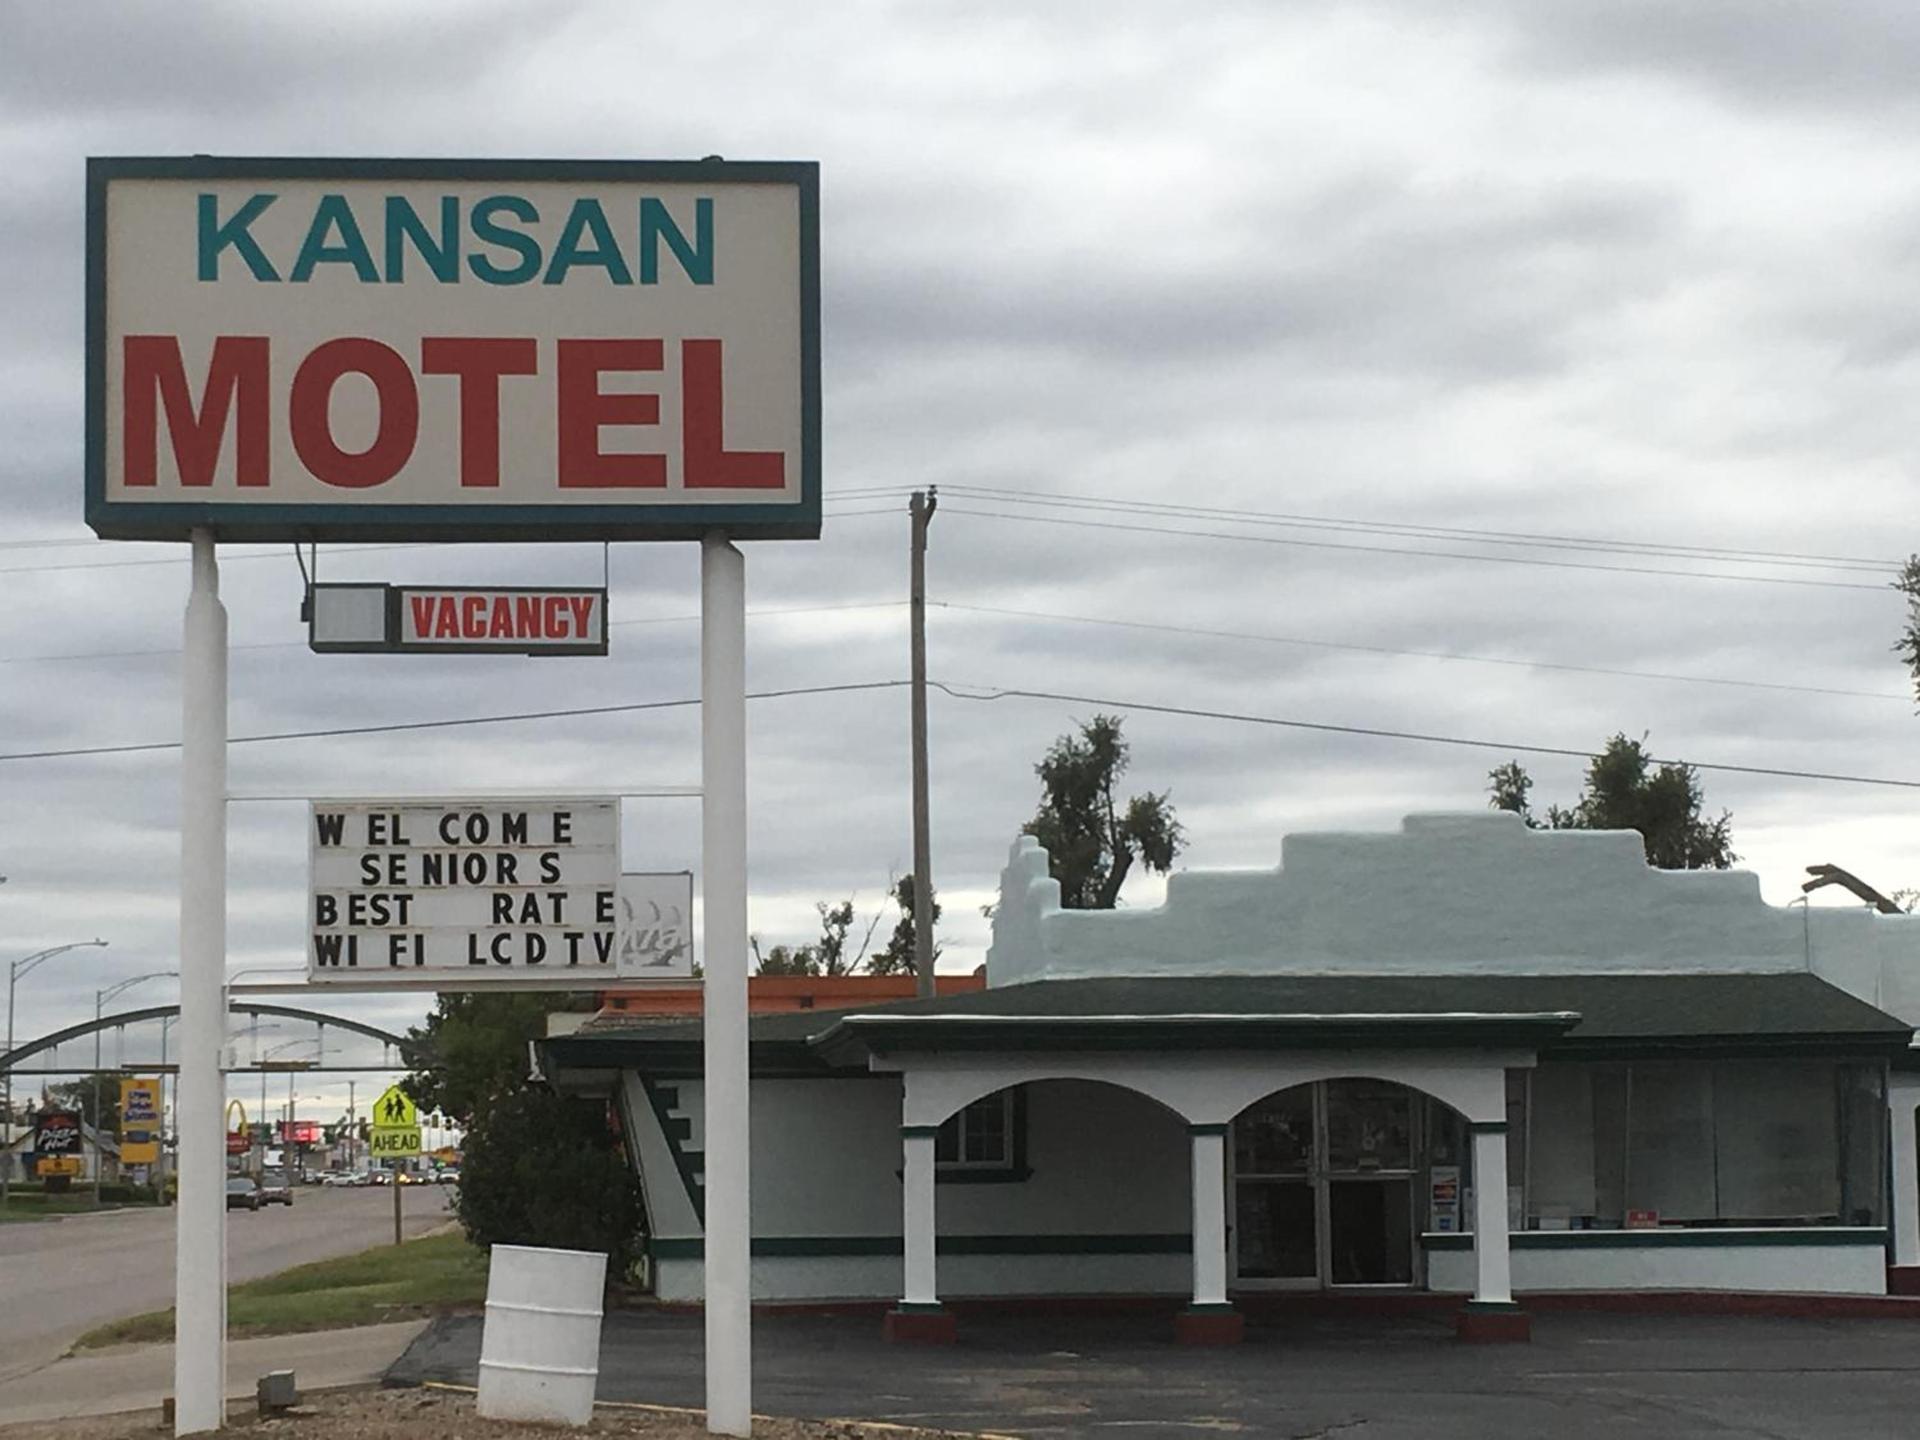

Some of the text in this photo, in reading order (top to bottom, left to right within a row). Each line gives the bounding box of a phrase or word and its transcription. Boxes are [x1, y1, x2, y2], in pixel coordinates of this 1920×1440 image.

[198, 195, 712, 283] KANSAN
[124, 336, 784, 488] MOTEL
[412, 596, 591, 637] VACANCY
[316, 812, 571, 845] WELCOME
[361, 852, 560, 885] SENIORS
[316, 891, 614, 926] BEST RATE
[373, 1134, 420, 1150] AHEAD
